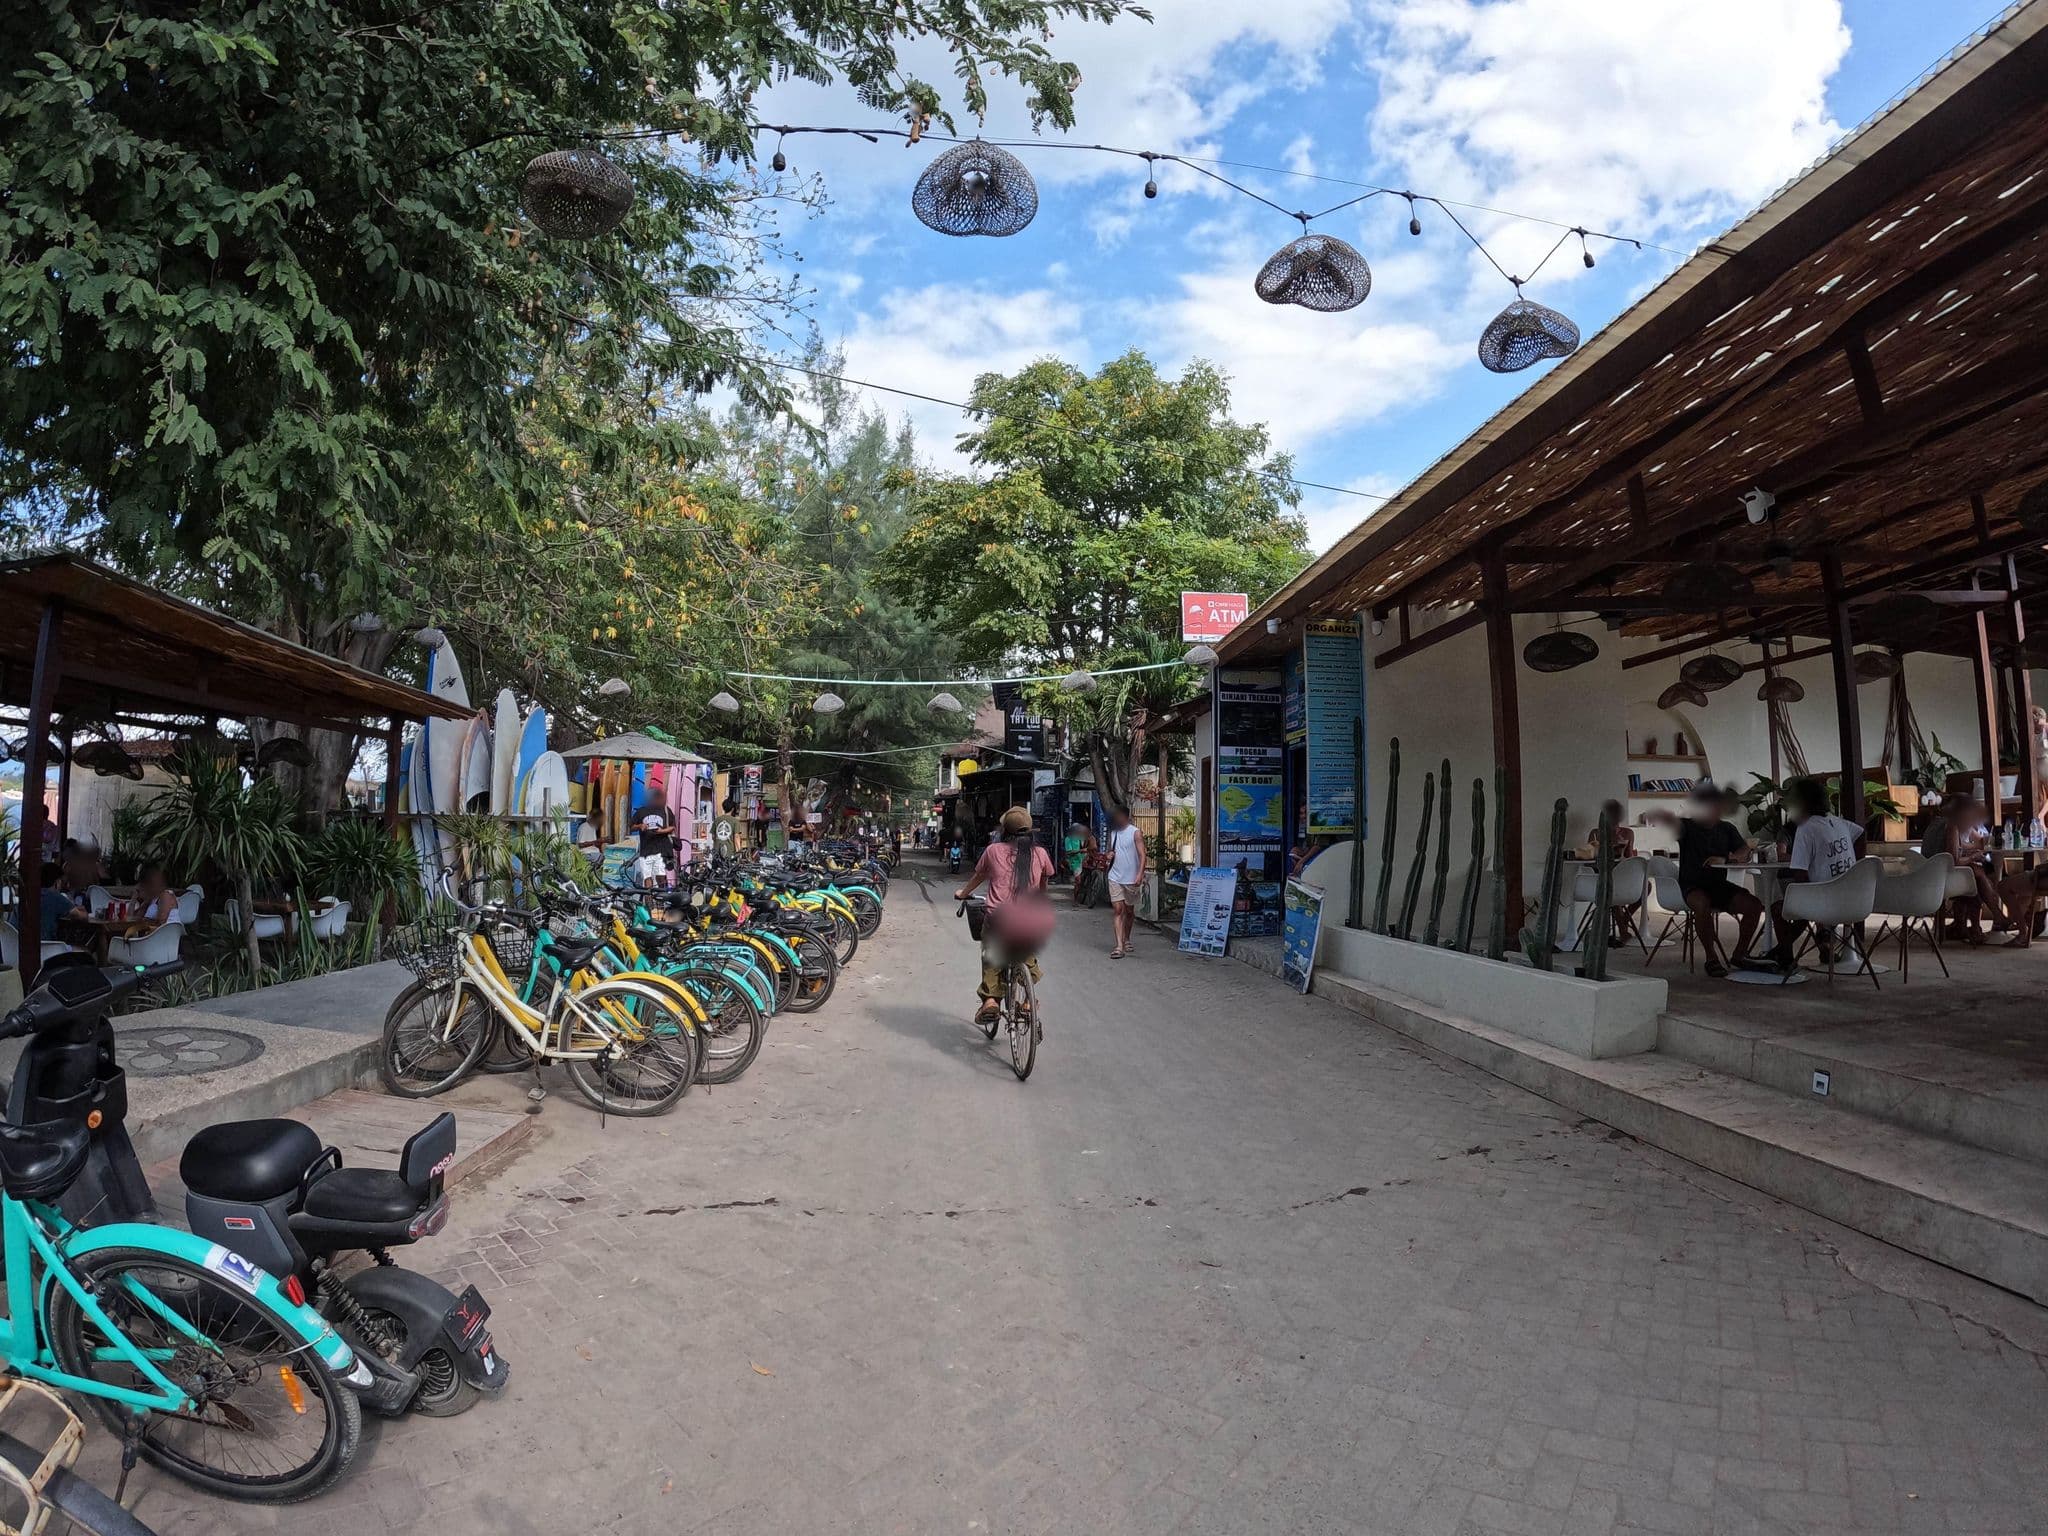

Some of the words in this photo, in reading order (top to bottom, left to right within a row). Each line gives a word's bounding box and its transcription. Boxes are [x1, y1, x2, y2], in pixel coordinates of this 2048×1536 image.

[1209, 609, 1244, 623] ATM
[1235, 747, 1268, 756] PROGRAM
[1228, 776, 1250, 785] FAST
[1251, 777, 1274, 785] BOAT
[1220, 844, 1246, 852] KOMODO
